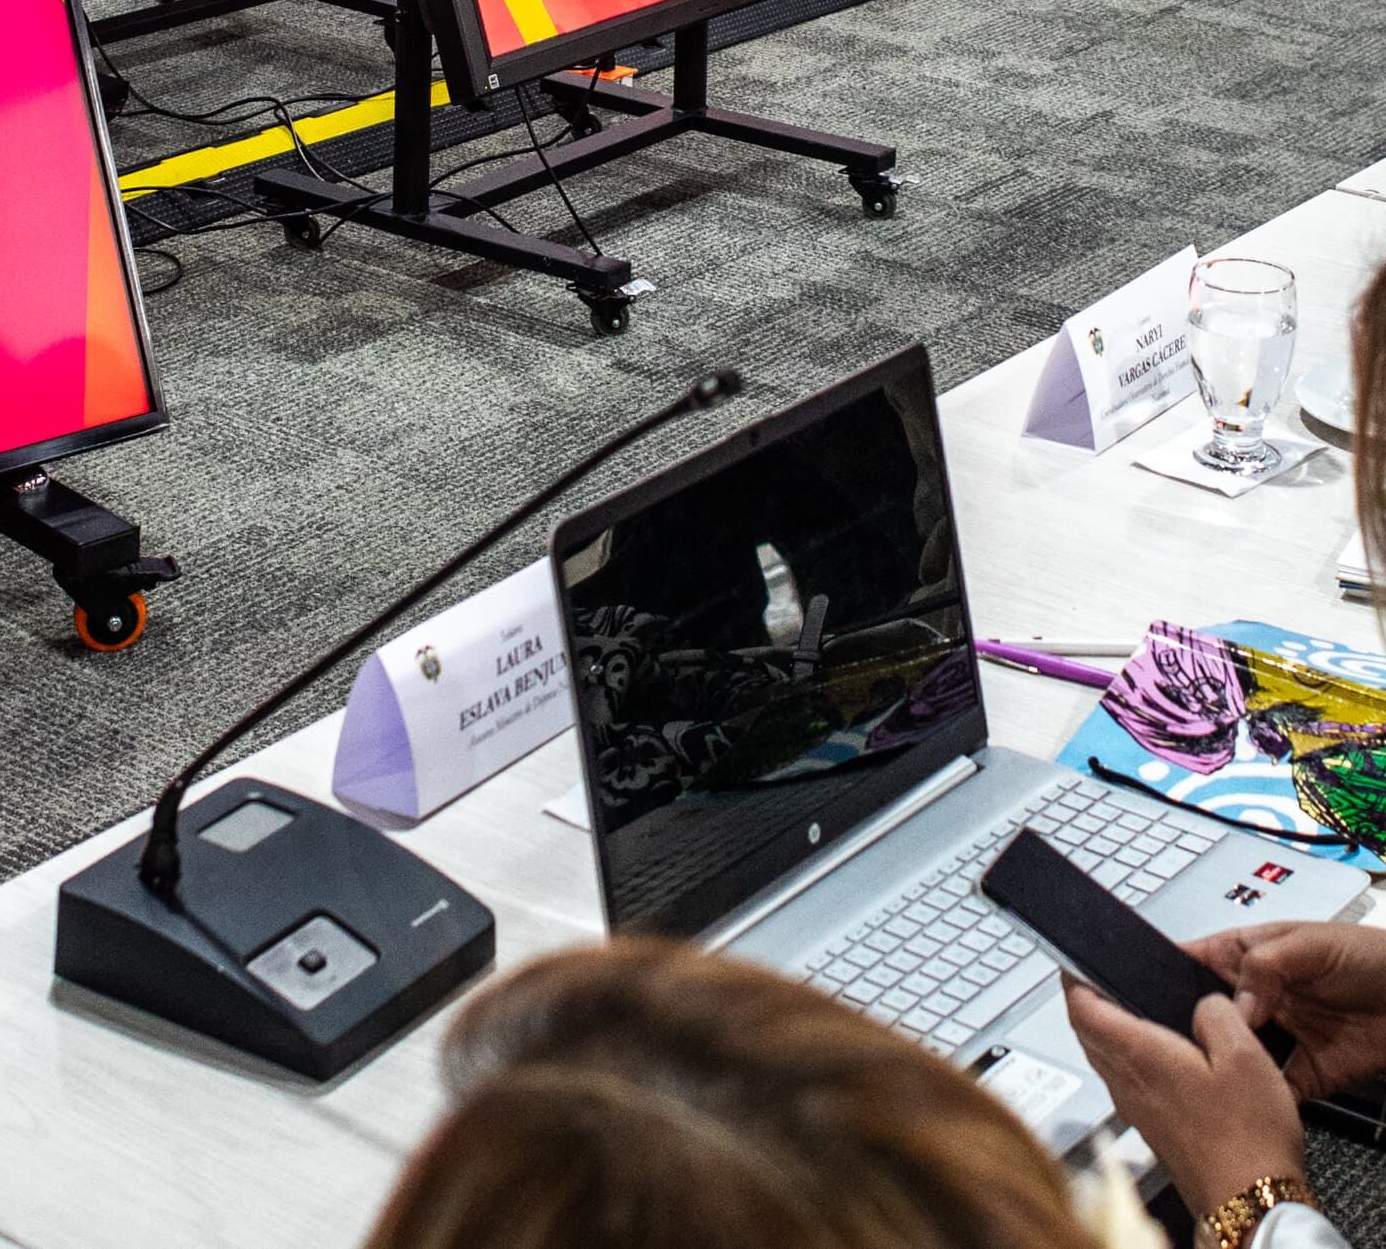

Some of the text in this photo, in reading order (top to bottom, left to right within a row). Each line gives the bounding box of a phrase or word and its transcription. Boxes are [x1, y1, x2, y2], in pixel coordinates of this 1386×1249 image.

[1135, 324, 1163, 350] NARYI
[1118, 334, 1187, 388] VARGAS CÁCERE
[496, 635, 543, 676] LAURA
[460, 686, 511, 731] ESLAVA
